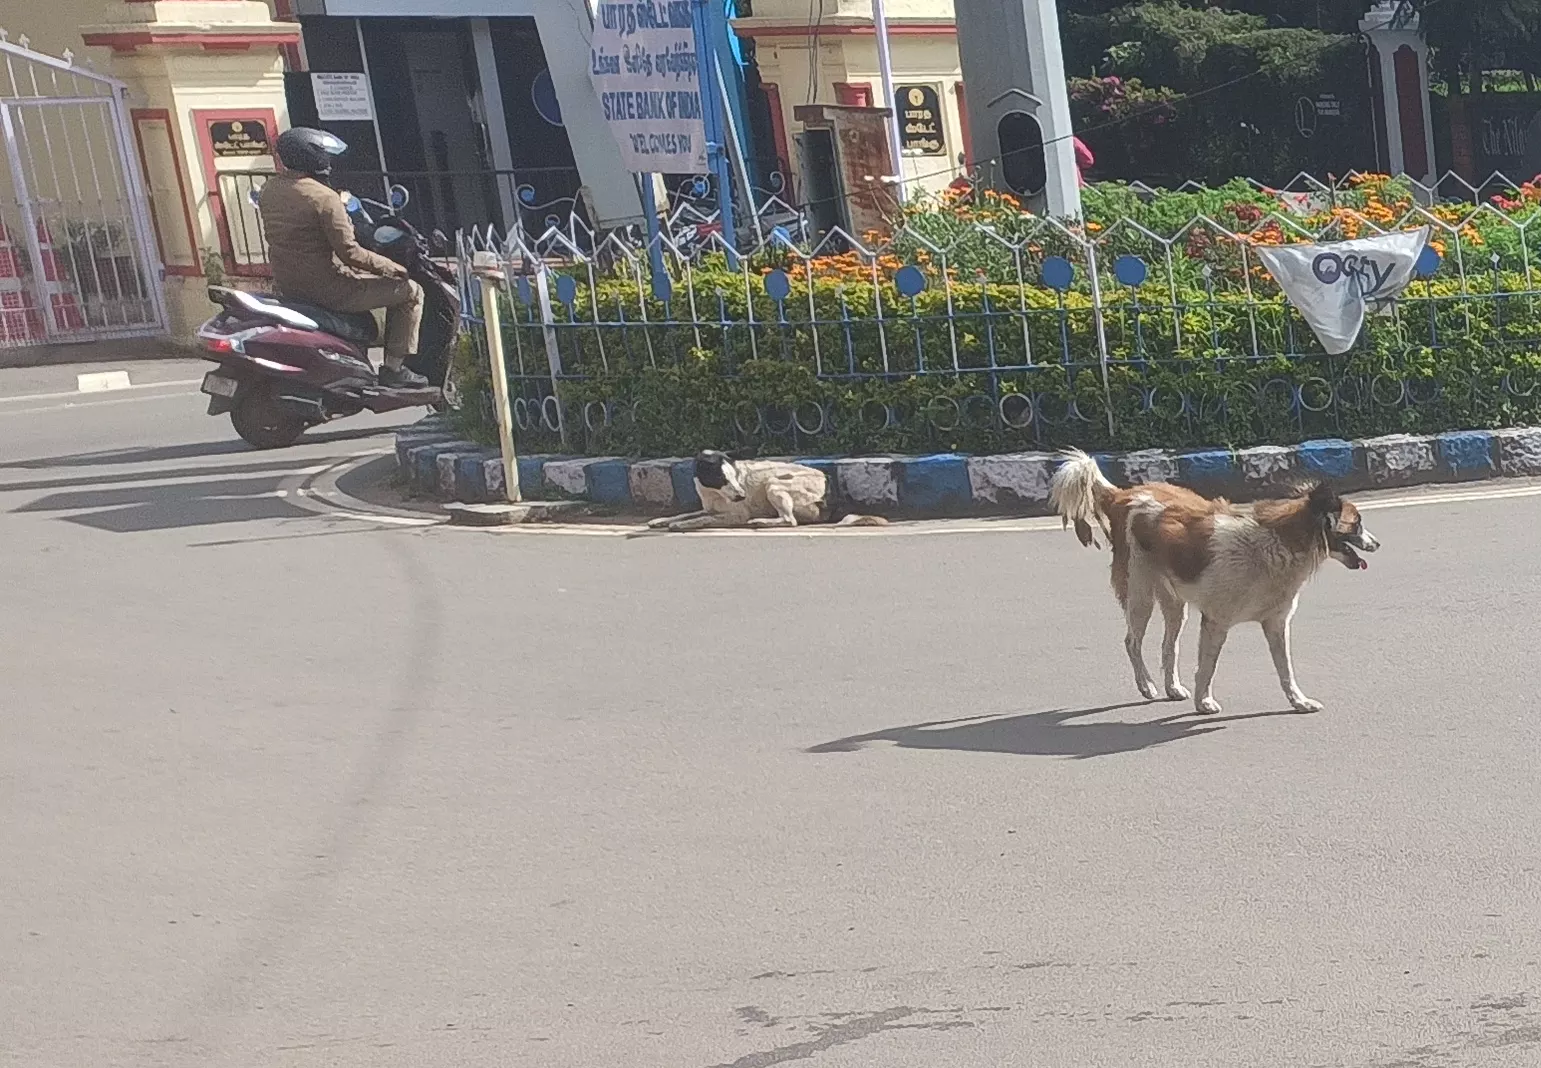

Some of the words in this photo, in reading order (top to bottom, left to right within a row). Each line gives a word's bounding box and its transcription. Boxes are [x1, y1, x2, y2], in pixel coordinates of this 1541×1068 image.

[602, 92, 635, 120] STATE
[636, 92, 666, 120] BANK
[666, 91, 678, 119] OF
[678, 91, 702, 119] INDIA
